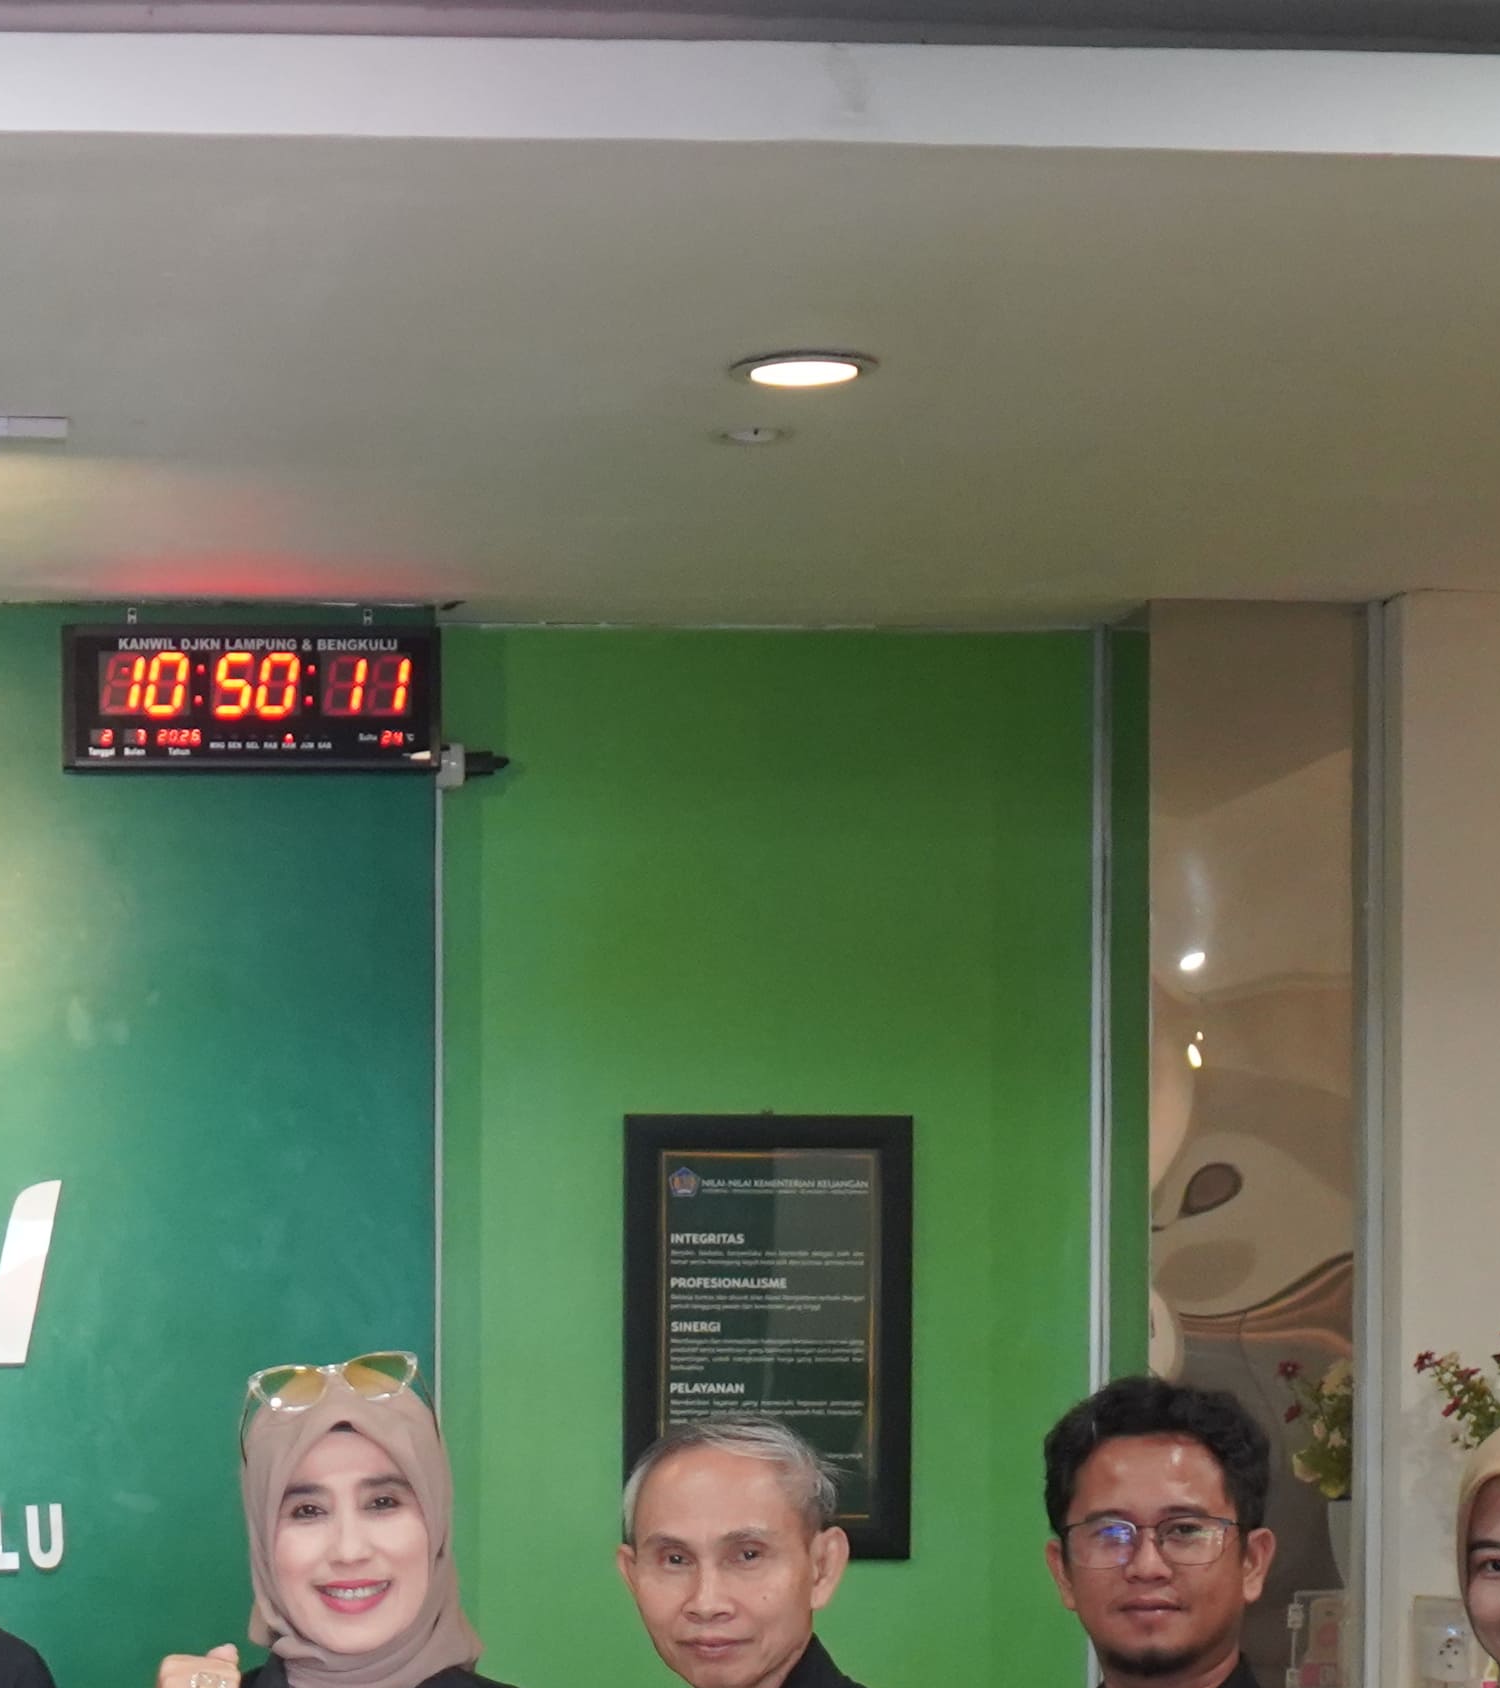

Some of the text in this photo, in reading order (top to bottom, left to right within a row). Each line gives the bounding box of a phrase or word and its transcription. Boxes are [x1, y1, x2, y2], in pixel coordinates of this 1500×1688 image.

[118, 638, 398, 651] KANWIL DJKN LAMPUNG & BENGKULU
[101, 728, 114, 746] 2
[670, 1233, 745, 1245] INTEGRITAS
[670, 1277, 788, 1289] PROFESIONALISME
[670, 1321, 721, 1333] SINERGI
[670, 1382, 745, 1394] PELAYANAN
